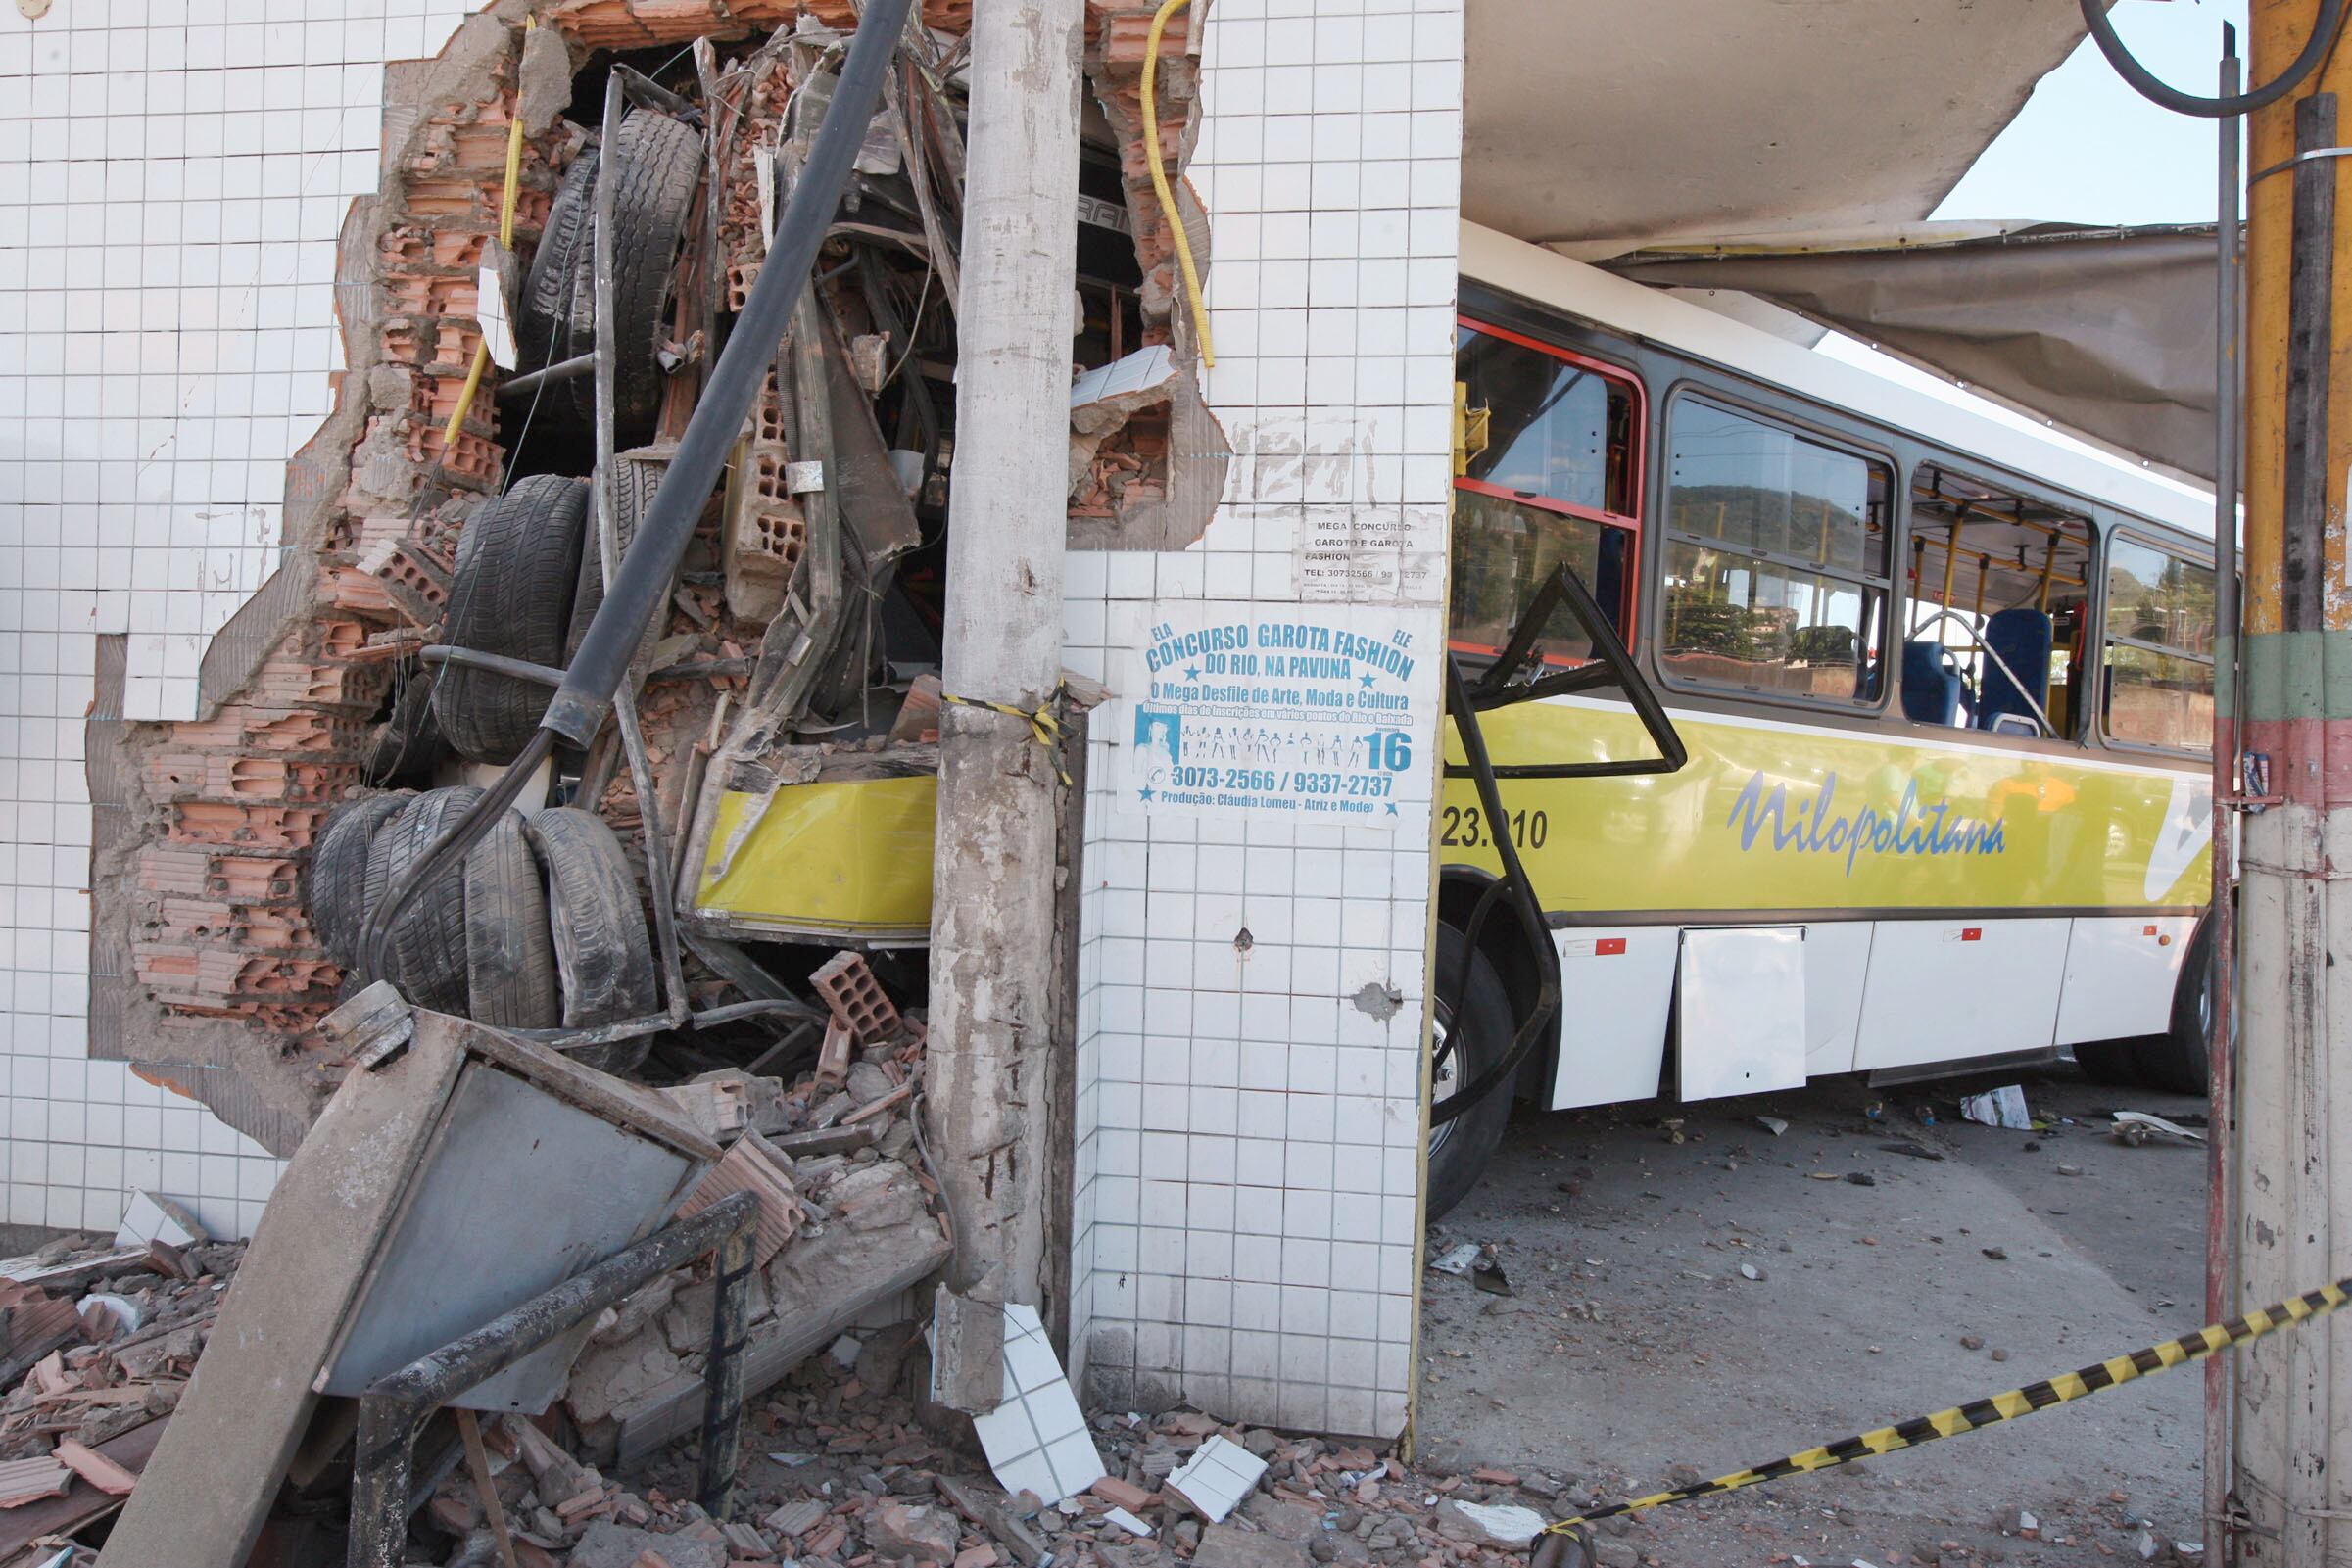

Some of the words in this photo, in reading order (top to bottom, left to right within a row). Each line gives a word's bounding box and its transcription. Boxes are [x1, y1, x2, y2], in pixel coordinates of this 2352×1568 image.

[1317, 522, 1347, 531] MEGA
[1327, 569, 1373, 578] 30732566
[1150, 622, 1173, 642] ELA
[1392, 629, 1413, 648] ELE
[1145, 624, 1248, 673] CONCURSO
[1258, 623, 1329, 652] GAROTA
[1333, 630, 1415, 682] FASHION
[1205, 653, 1226, 674] DO
[1230, 654, 1261, 677] RIO,
[1265, 655, 1285, 677] NA
[1289, 656, 1351, 680] PAVUNA
[1150, 682, 1160, 699] O
[1163, 682, 1199, 702] Mega
[1202, 684, 1249, 703] Desfile
[1252, 687, 1269, 704] de
[1272, 688, 1303, 705] Arte,
[1306, 689, 1343, 707] Moda
[1346, 692, 1355, 707] e
[1358, 690, 1409, 710] Cultura
[1199, 704, 1212, 716] de
[1363, 732, 1412, 772] 16
[1172, 766, 1275, 791] 3073-2566
[1279, 771, 1289, 792] /
[1294, 772, 1392, 797] 9337-2737
[1161, 790, 1215, 806] Produção:
[1218, 793, 1258, 808] Cláudia
[1260, 795, 1296, 810] Lomeu
[1304, 798, 1329, 811] Atriz
[1330, 801, 1337, 811] e
[1727, 769, 2006, 879] Nilopolitana
